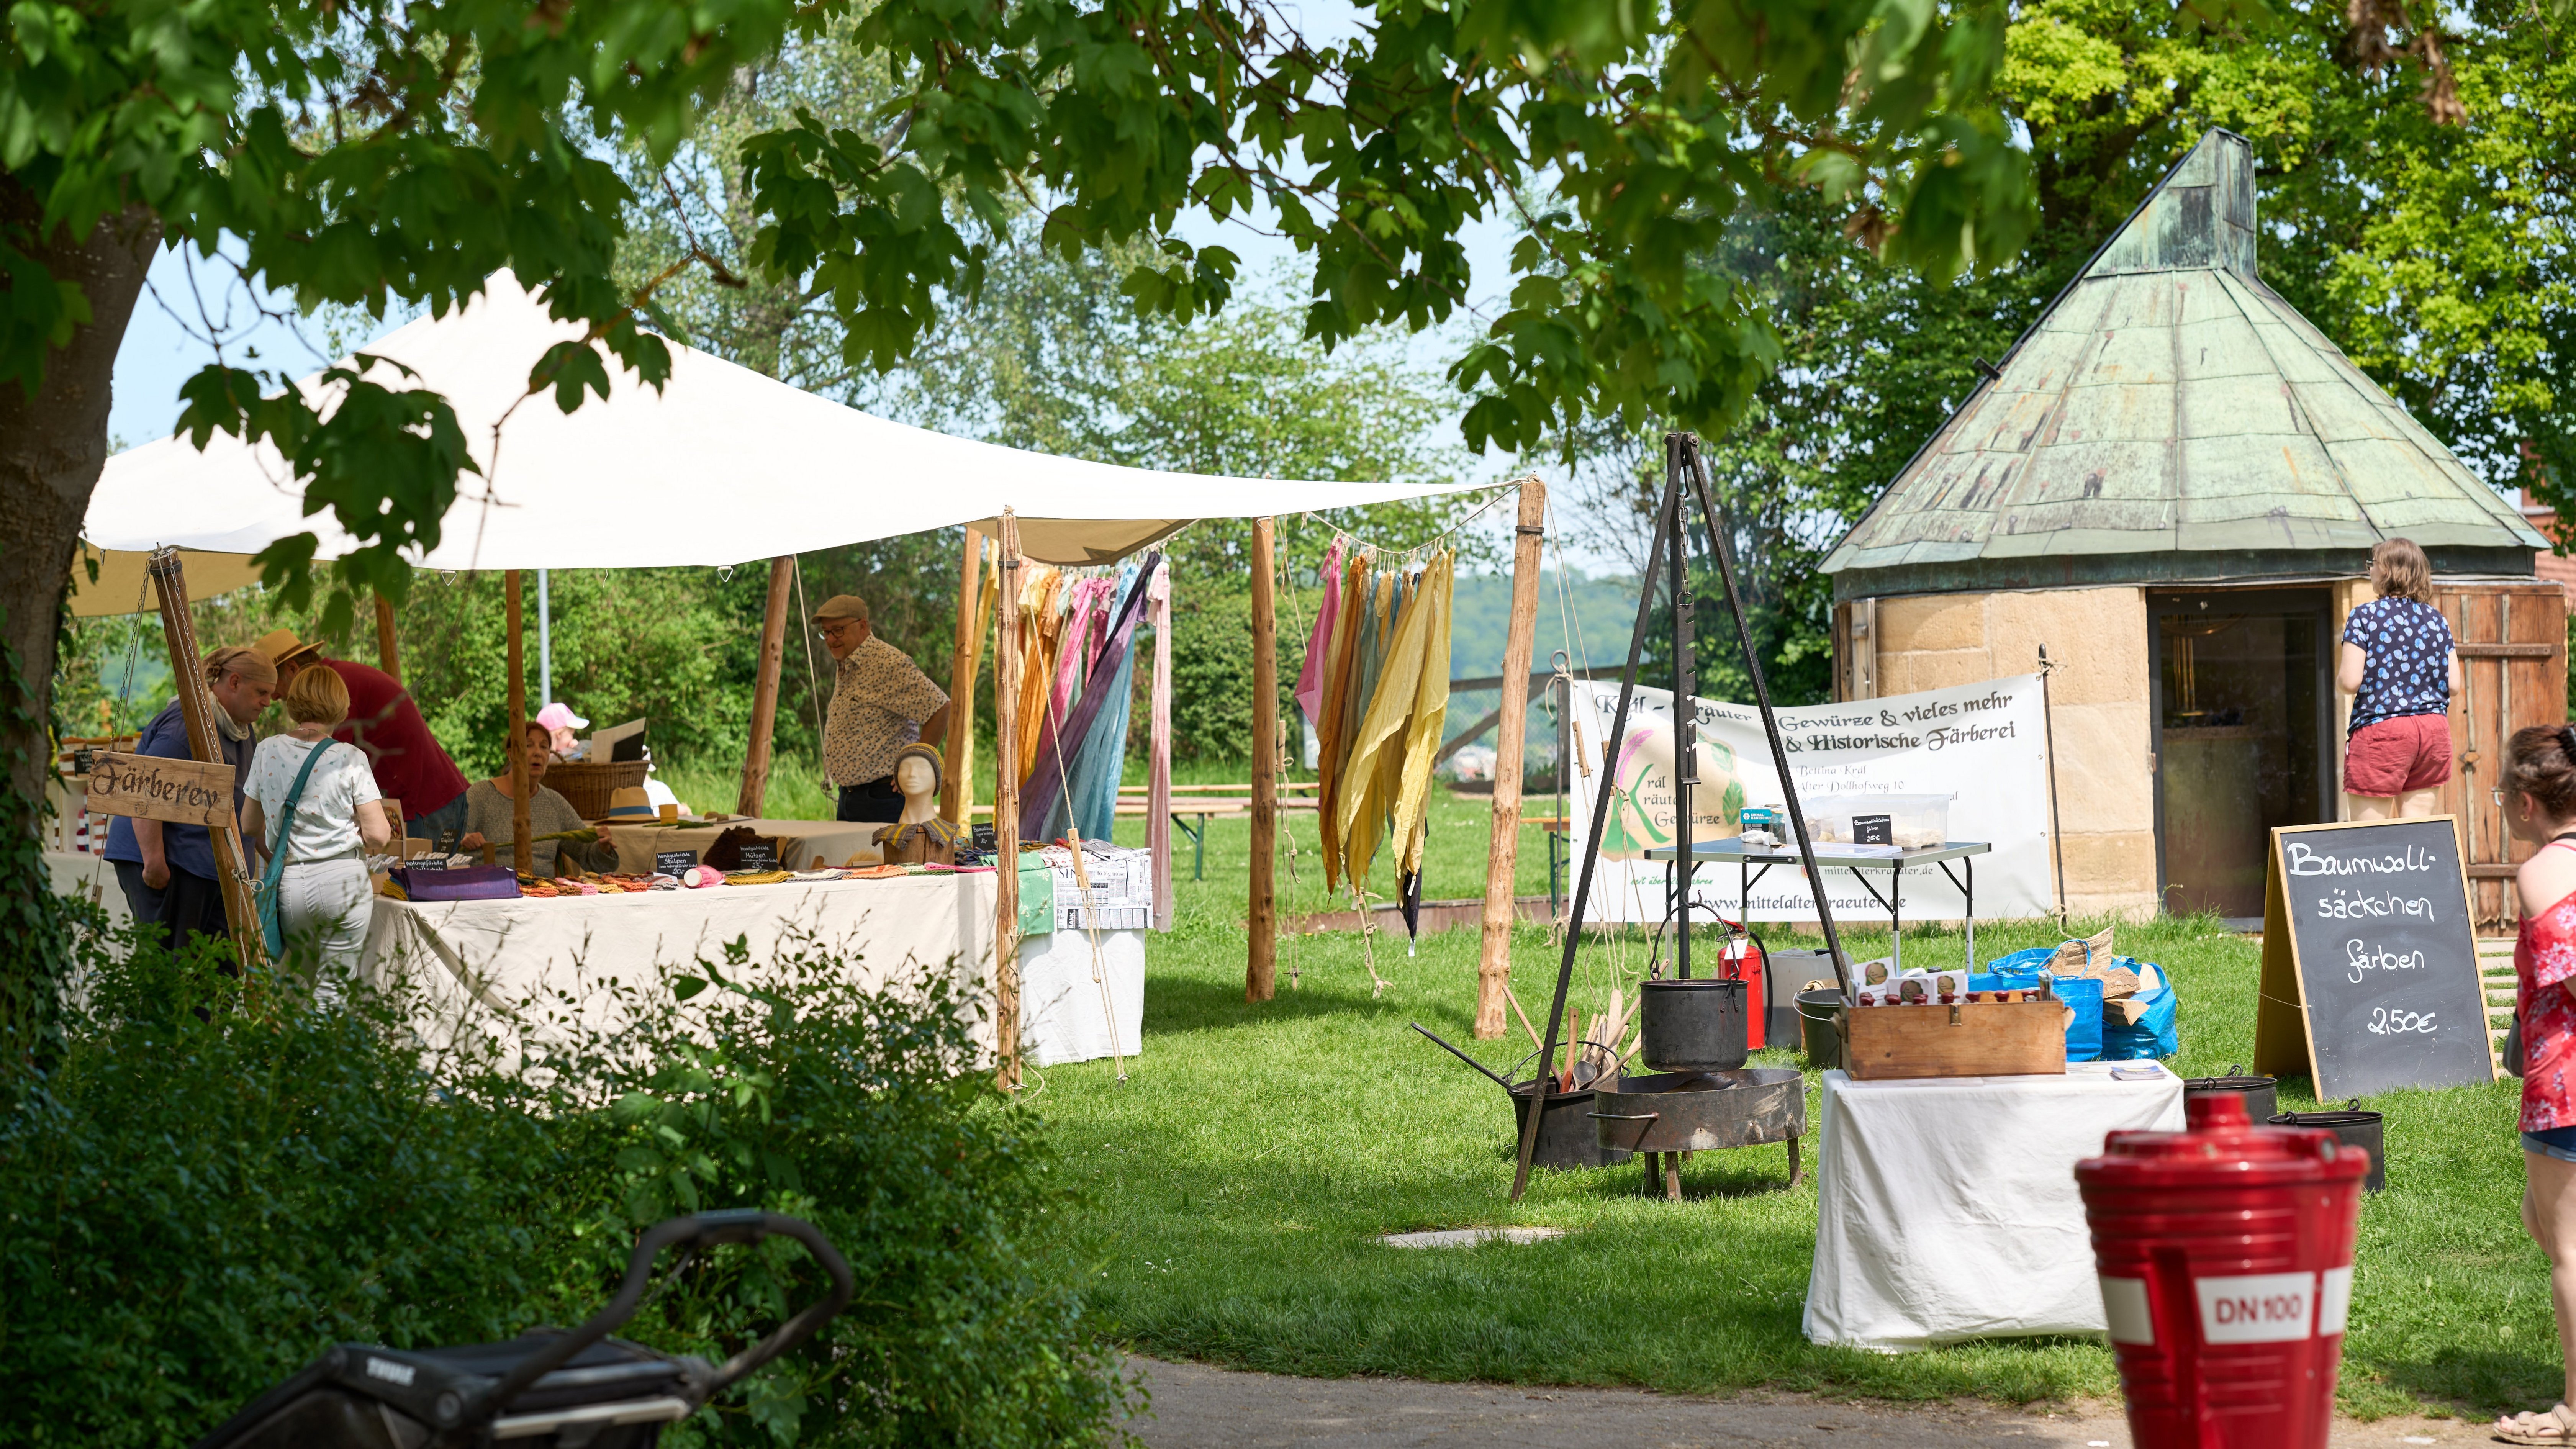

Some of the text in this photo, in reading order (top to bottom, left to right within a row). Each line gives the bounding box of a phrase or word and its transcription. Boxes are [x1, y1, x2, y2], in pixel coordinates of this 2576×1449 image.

[1595, 695, 1646, 721] Kál
[1672, 705, 1752, 725] räuter
[1778, 715, 1874, 731] Gewürze
[1880, 710, 1900, 727] &
[1901, 701, 1958, 723] vieles
[1963, 691, 2013, 712] mehr
[1785, 721, 2016, 752] & Historische Färberei
[1796, 765, 1867, 778] Bettina Král
[93, 757, 218, 825] Färberey
[1795, 781, 1904, 794] Alter Dollhofweg 10
[1644, 794, 1677, 805] räute
[1654, 811, 1720, 827] Geürze
[406, 860, 444, 868] naturgefärbte
[1824, 865, 1933, 876] mittellterkrauter.de
[2286, 842, 2436, 876] Baumwoll-
[1631, 876, 1646, 884] seit
[1691, 874, 1713, 885] ahren
[1692, 892, 1907, 910] ww.mittelalterraeutere
[2319, 888, 2435, 922] säckchen
[2347, 939, 2424, 983] färben
[2367, 1007, 2438, 1035] 2,50€
[366, 1357, 415, 1386] THULE
